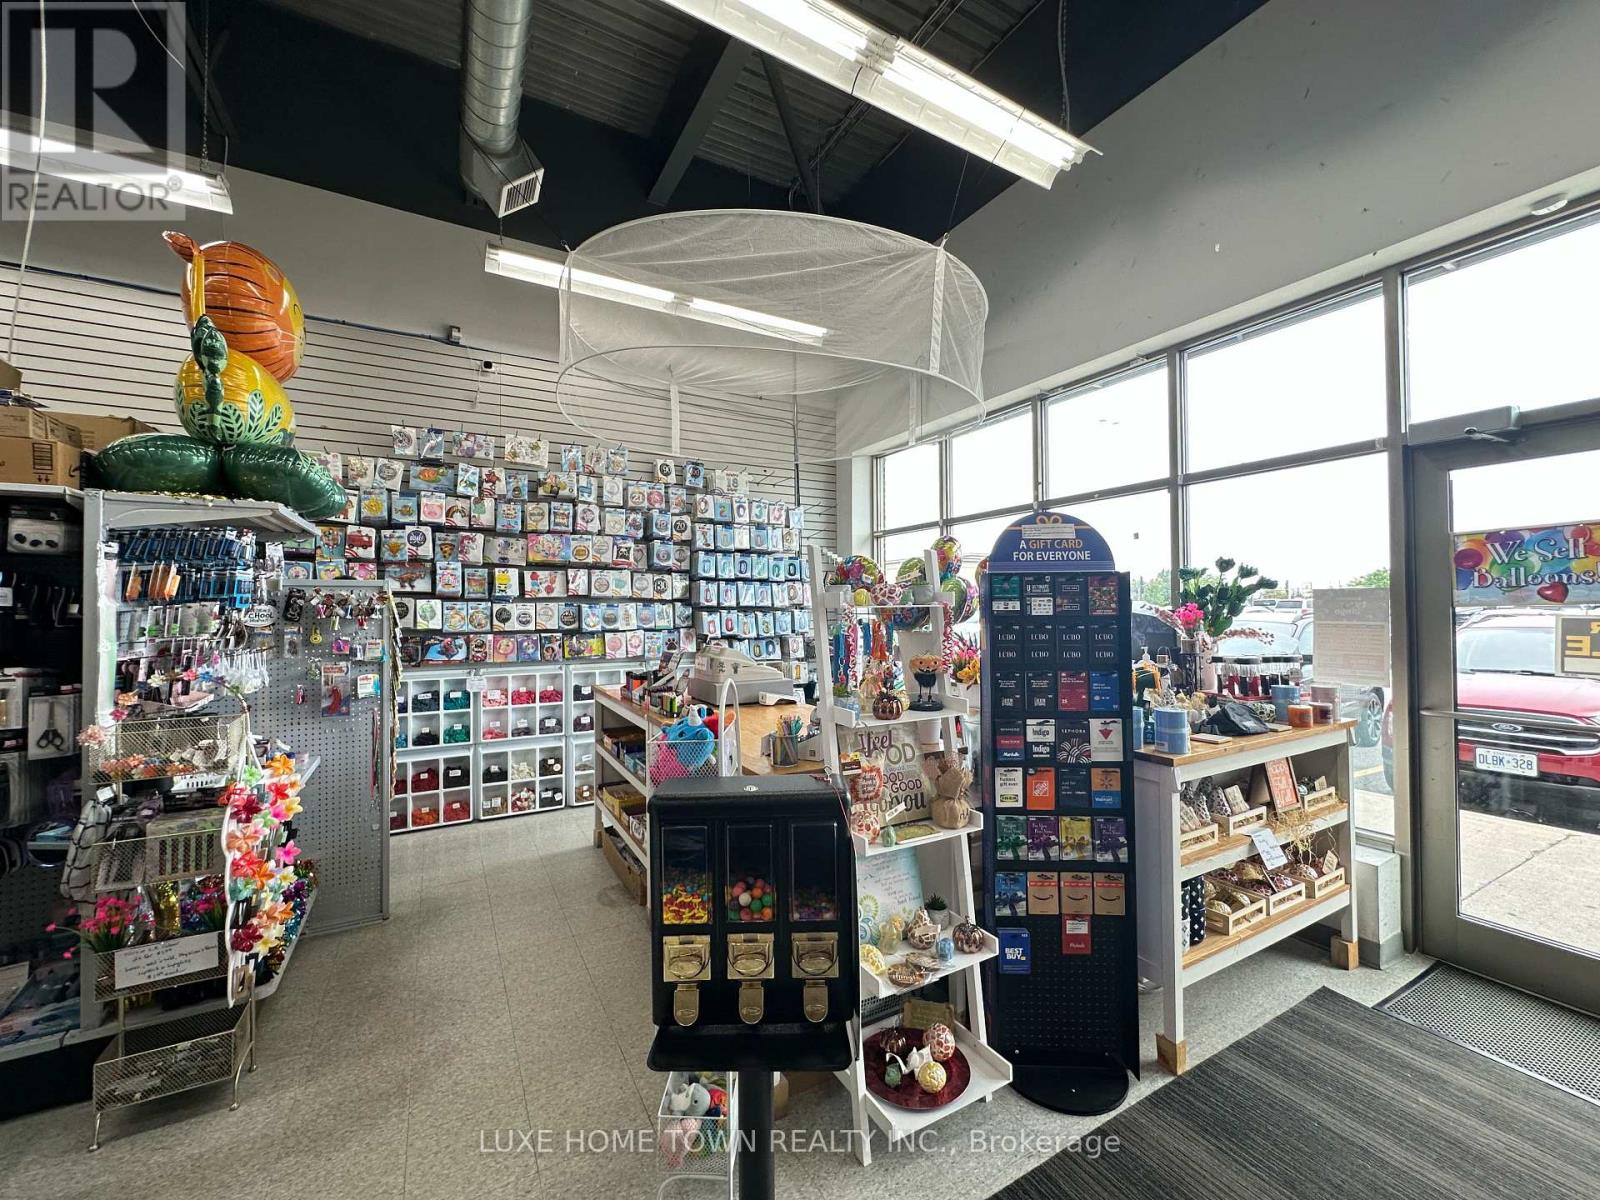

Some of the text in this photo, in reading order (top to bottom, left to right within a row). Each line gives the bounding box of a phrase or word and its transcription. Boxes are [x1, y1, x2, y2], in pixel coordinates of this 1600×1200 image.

[1019, 540, 1083, 549] A GIFT CARD
[1486, 537, 1588, 565] We Sell
[1013, 551, 1091, 561] FOR EVERYONE
[1032, 728, 1049, 737] Indigo
[1032, 744, 1050, 753] Indigo
[891, 778, 922, 793] GOOD
